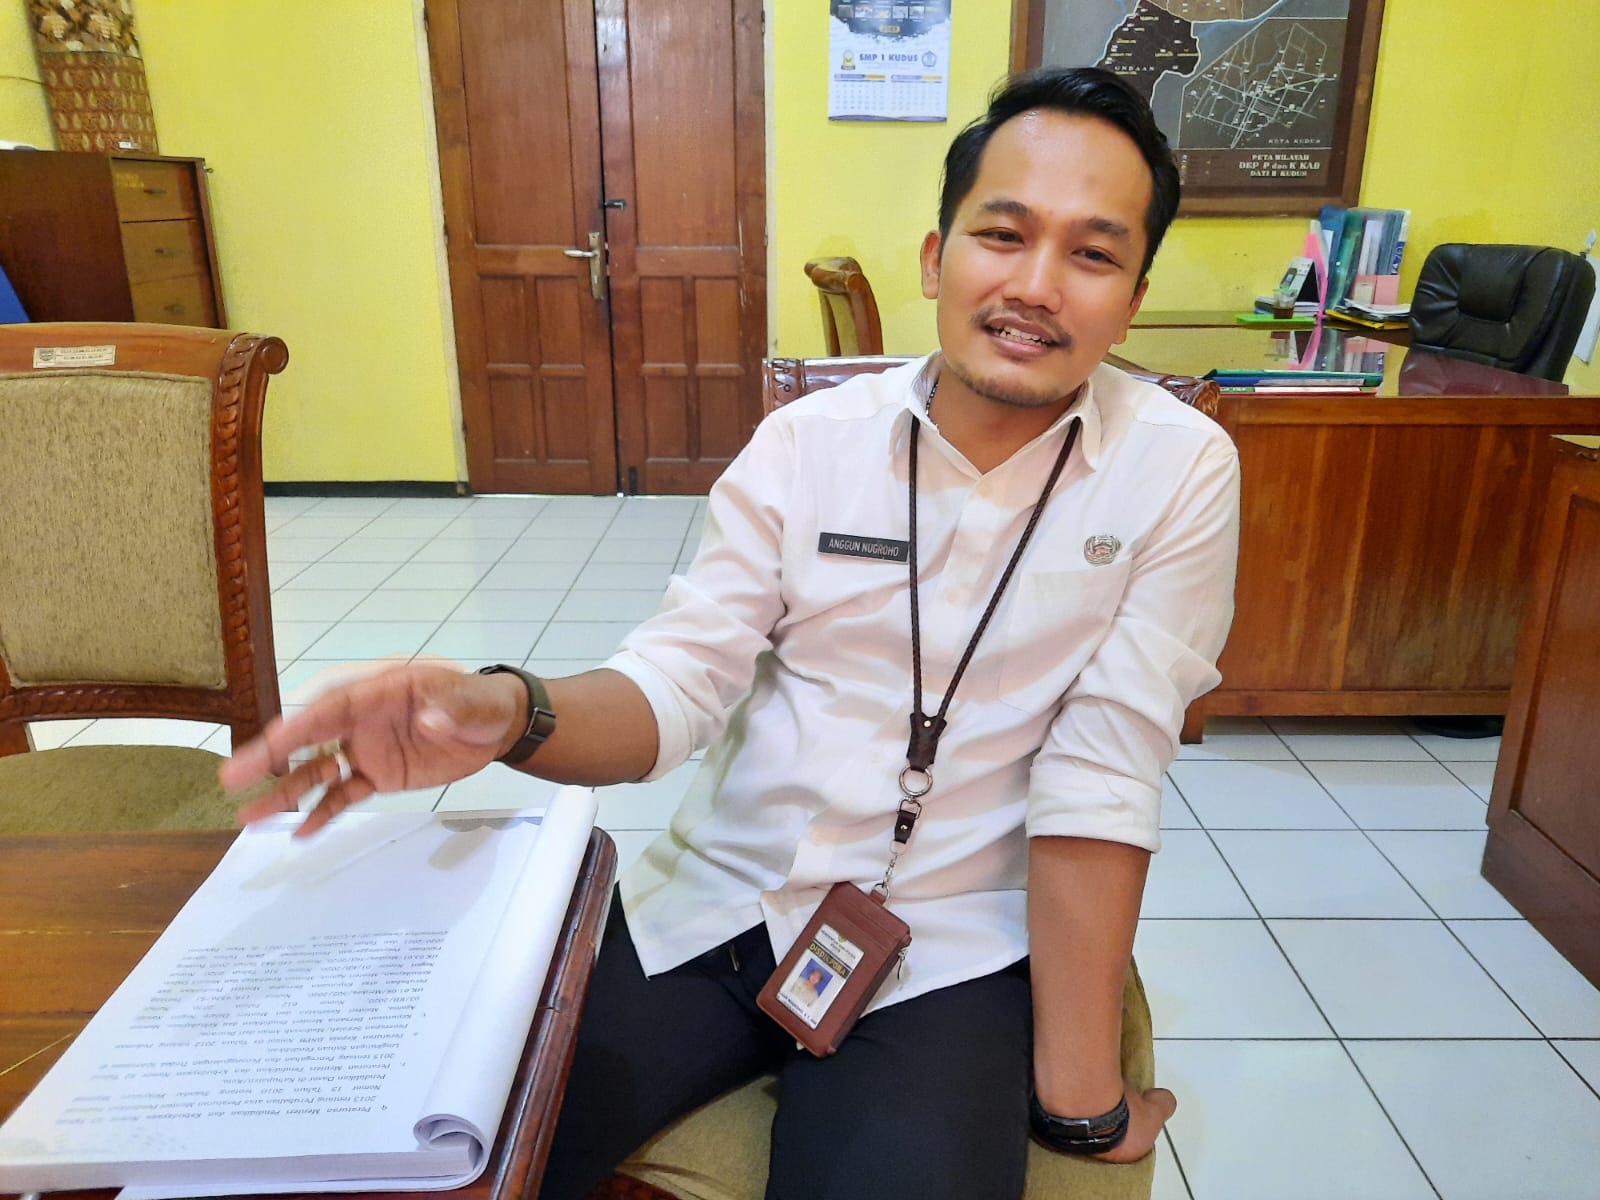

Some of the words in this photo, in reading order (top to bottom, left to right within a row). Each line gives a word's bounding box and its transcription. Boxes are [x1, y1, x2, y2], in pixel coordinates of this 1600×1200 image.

[859, 53, 878, 62] SMP
[888, 53, 918, 63] KUDUS
[1239, 161, 1259, 169] DEP
[828, 538, 861, 551] ANGGUN
[861, 543, 899, 557] NUGROHO
